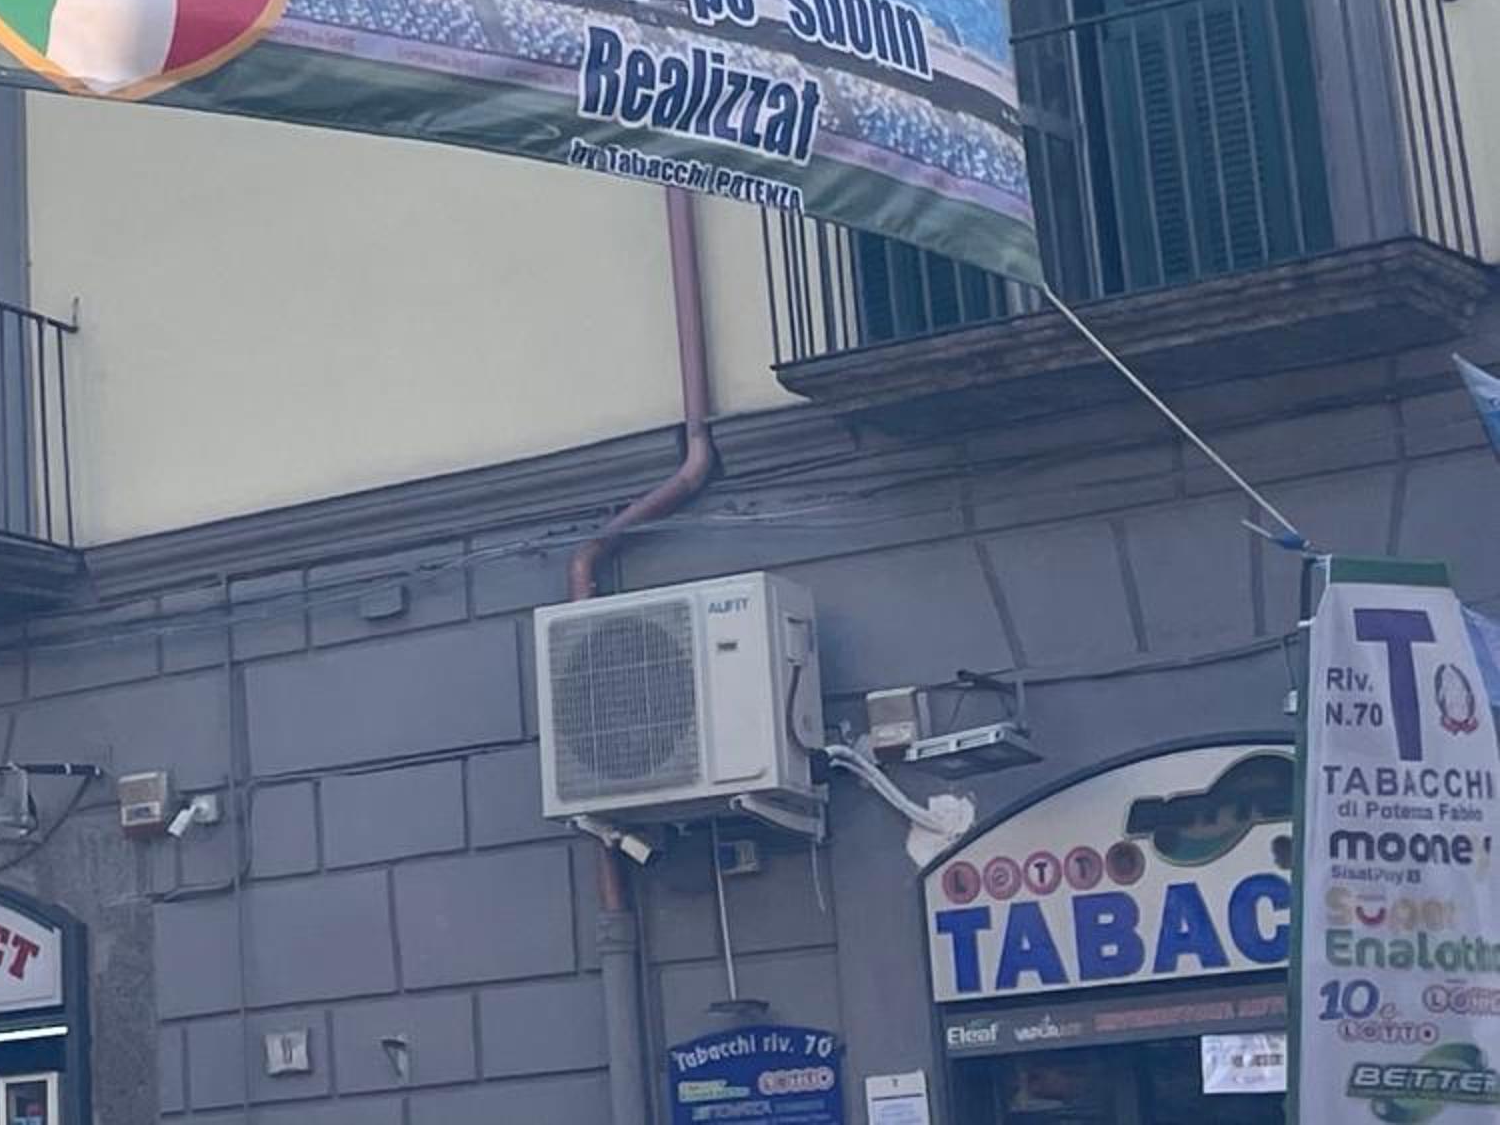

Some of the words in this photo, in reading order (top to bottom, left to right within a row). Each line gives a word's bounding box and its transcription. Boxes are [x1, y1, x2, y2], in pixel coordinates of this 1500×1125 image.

[582, 29, 821, 163] Realizzat
[603, 146, 708, 188] Tabacchi
[1353, 608, 1437, 762] T
[1325, 702, 1384, 726] N.70
[1323, 765, 1494, 800] TABACCHI
[1319, 979, 1380, 1021] 10
[946, 1024, 999, 1045] Eleaf
[1338, 1019, 1440, 1045] LOTTO
[673, 1034, 756, 1072] Tabacchi
[804, 1034, 834, 1058] 70
